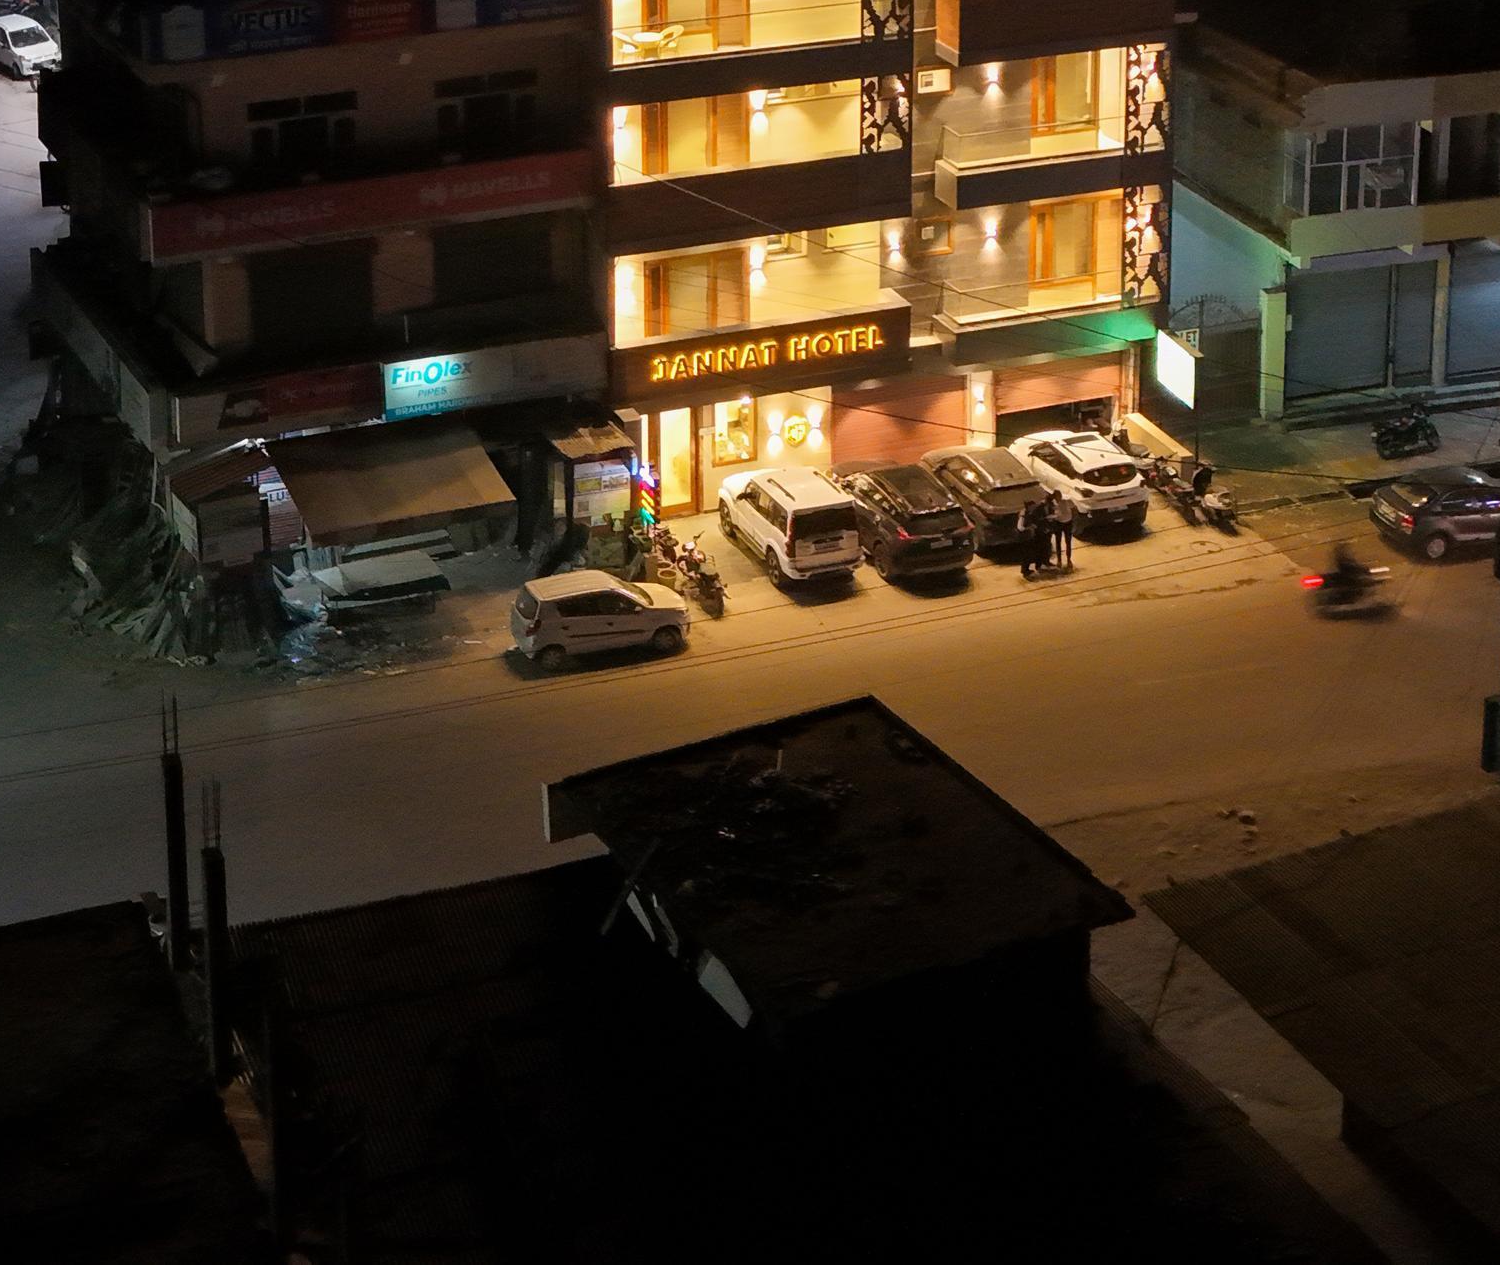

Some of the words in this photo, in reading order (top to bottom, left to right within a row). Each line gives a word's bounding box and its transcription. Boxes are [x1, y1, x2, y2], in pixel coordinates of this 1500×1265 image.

[230, 4, 312, 33] VECTUS
[652, 339, 778, 382] JANNAT
[789, 325, 884, 362] HOTEL
[417, 387, 448, 398] PIPES
[395, 402, 437, 416] BRAHAM
